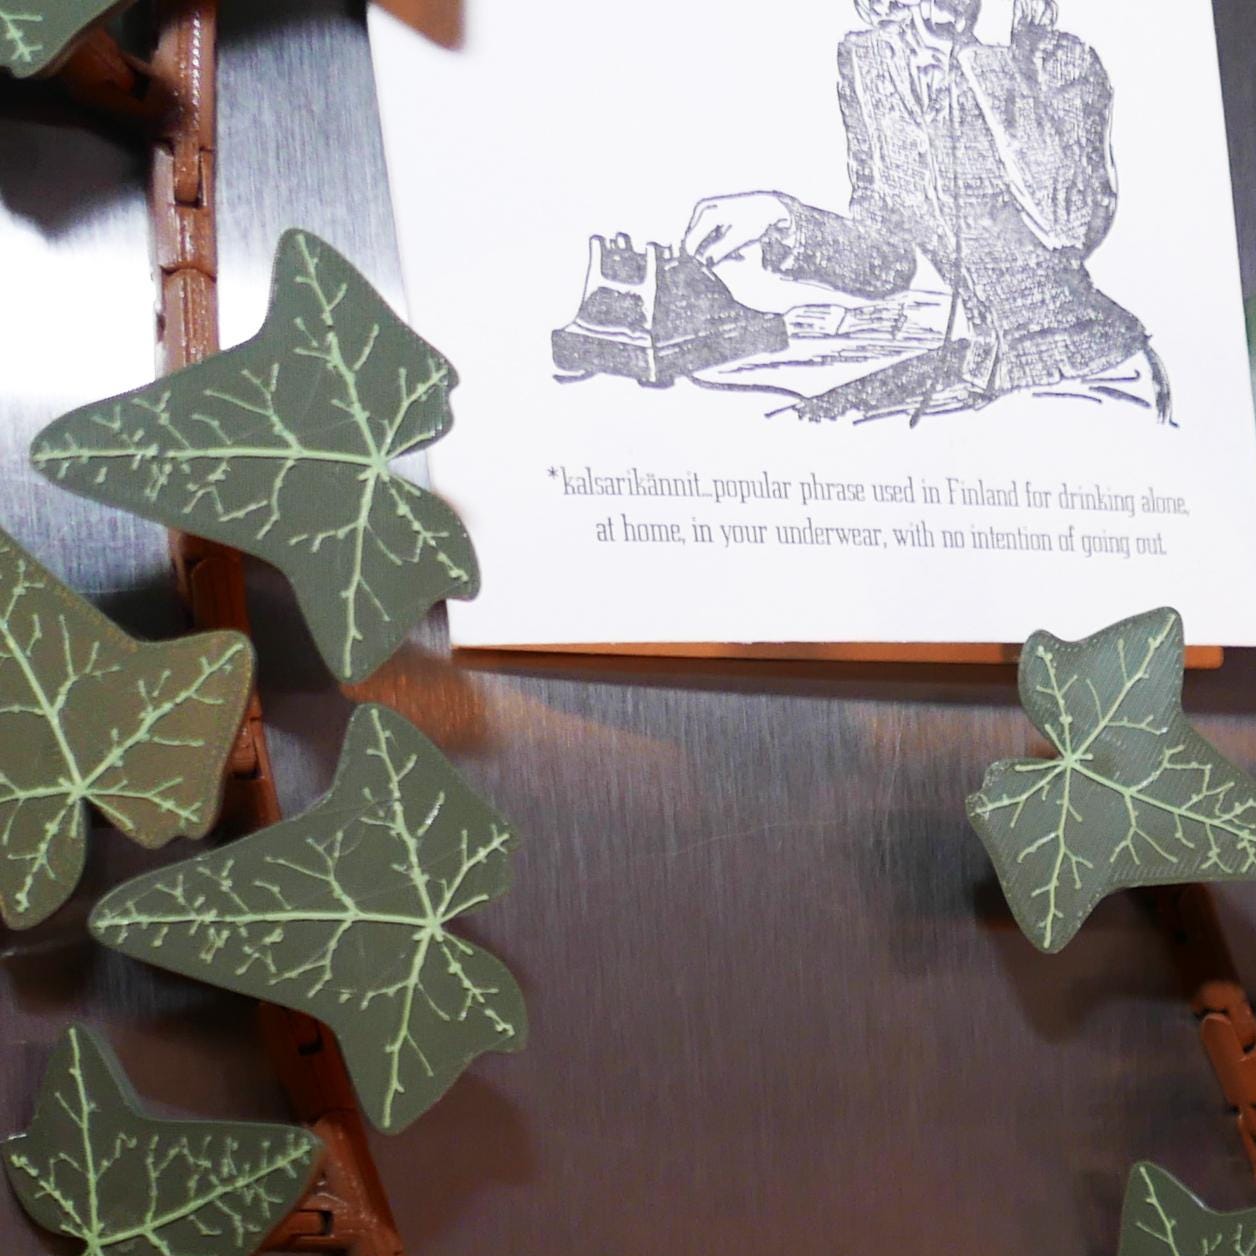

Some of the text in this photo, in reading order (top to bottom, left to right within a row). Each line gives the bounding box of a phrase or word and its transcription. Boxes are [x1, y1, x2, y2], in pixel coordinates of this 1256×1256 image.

[799, 472, 866, 506] phrase
[872, 475, 915, 504] used
[921, 478, 942, 505] in
[946, 477, 1019, 508] Finland
[1026, 481, 1052, 509] for
[1058, 482, 1136, 518] drinking
[596, 516, 616, 543] at
[621, 513, 686, 545] home,
[691, 516, 714, 544] in
[720, 524, 768, 549] your
[776, 517, 888, 549] underwear,
[892, 520, 935, 548] with
[941, 530, 965, 549] no
[970, 523, 1053, 552] intention
[1058, 525, 1075, 552] of
[1081, 530, 1131, 559] going
